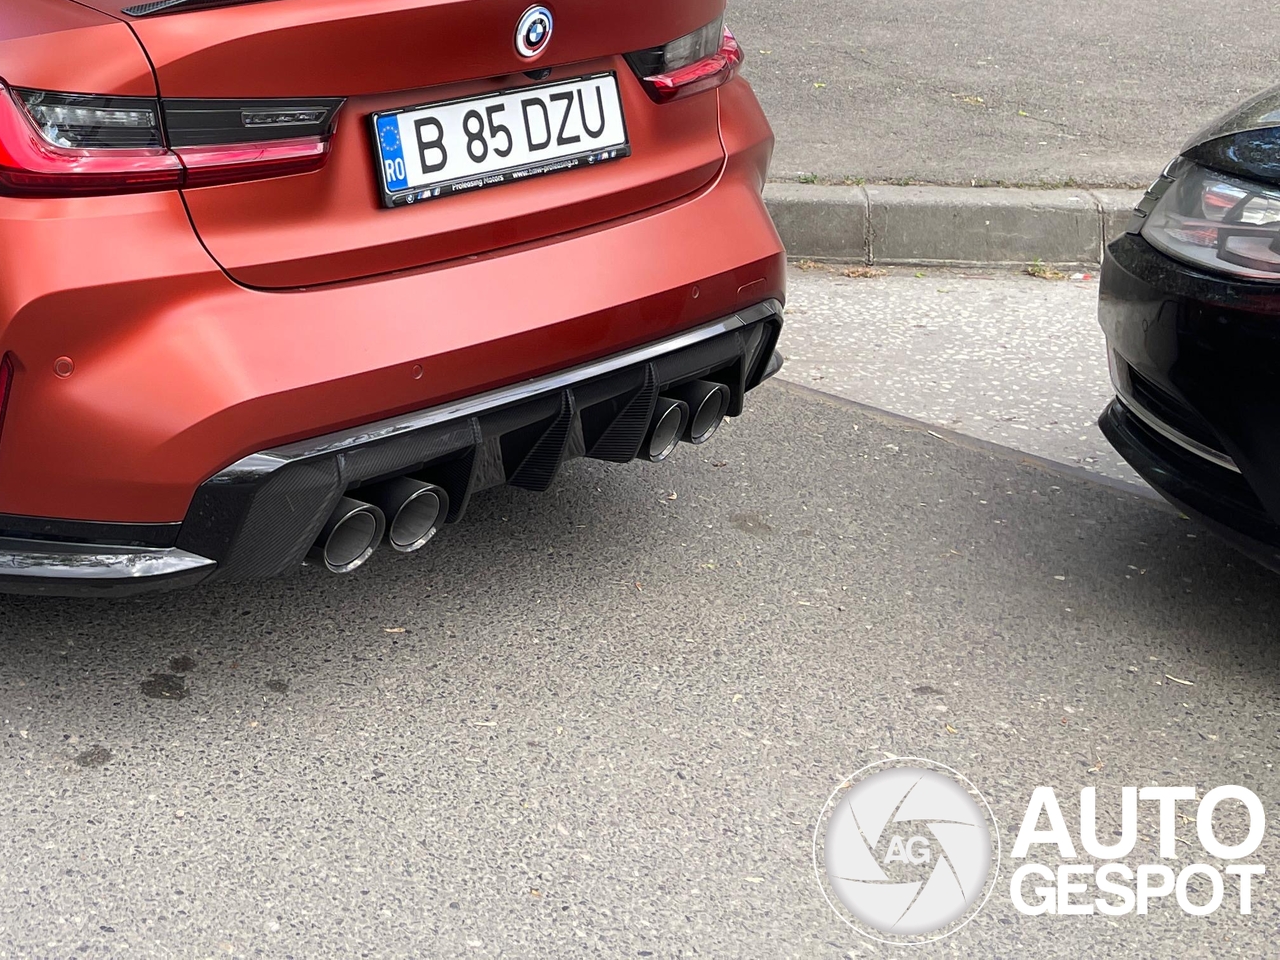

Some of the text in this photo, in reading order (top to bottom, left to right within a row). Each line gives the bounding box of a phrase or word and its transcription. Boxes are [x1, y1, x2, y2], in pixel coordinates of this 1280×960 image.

[413, 86, 606, 174] B 85 DZU
[385, 158, 406, 183] RO
[452, 178, 483, 191] Proleasing
